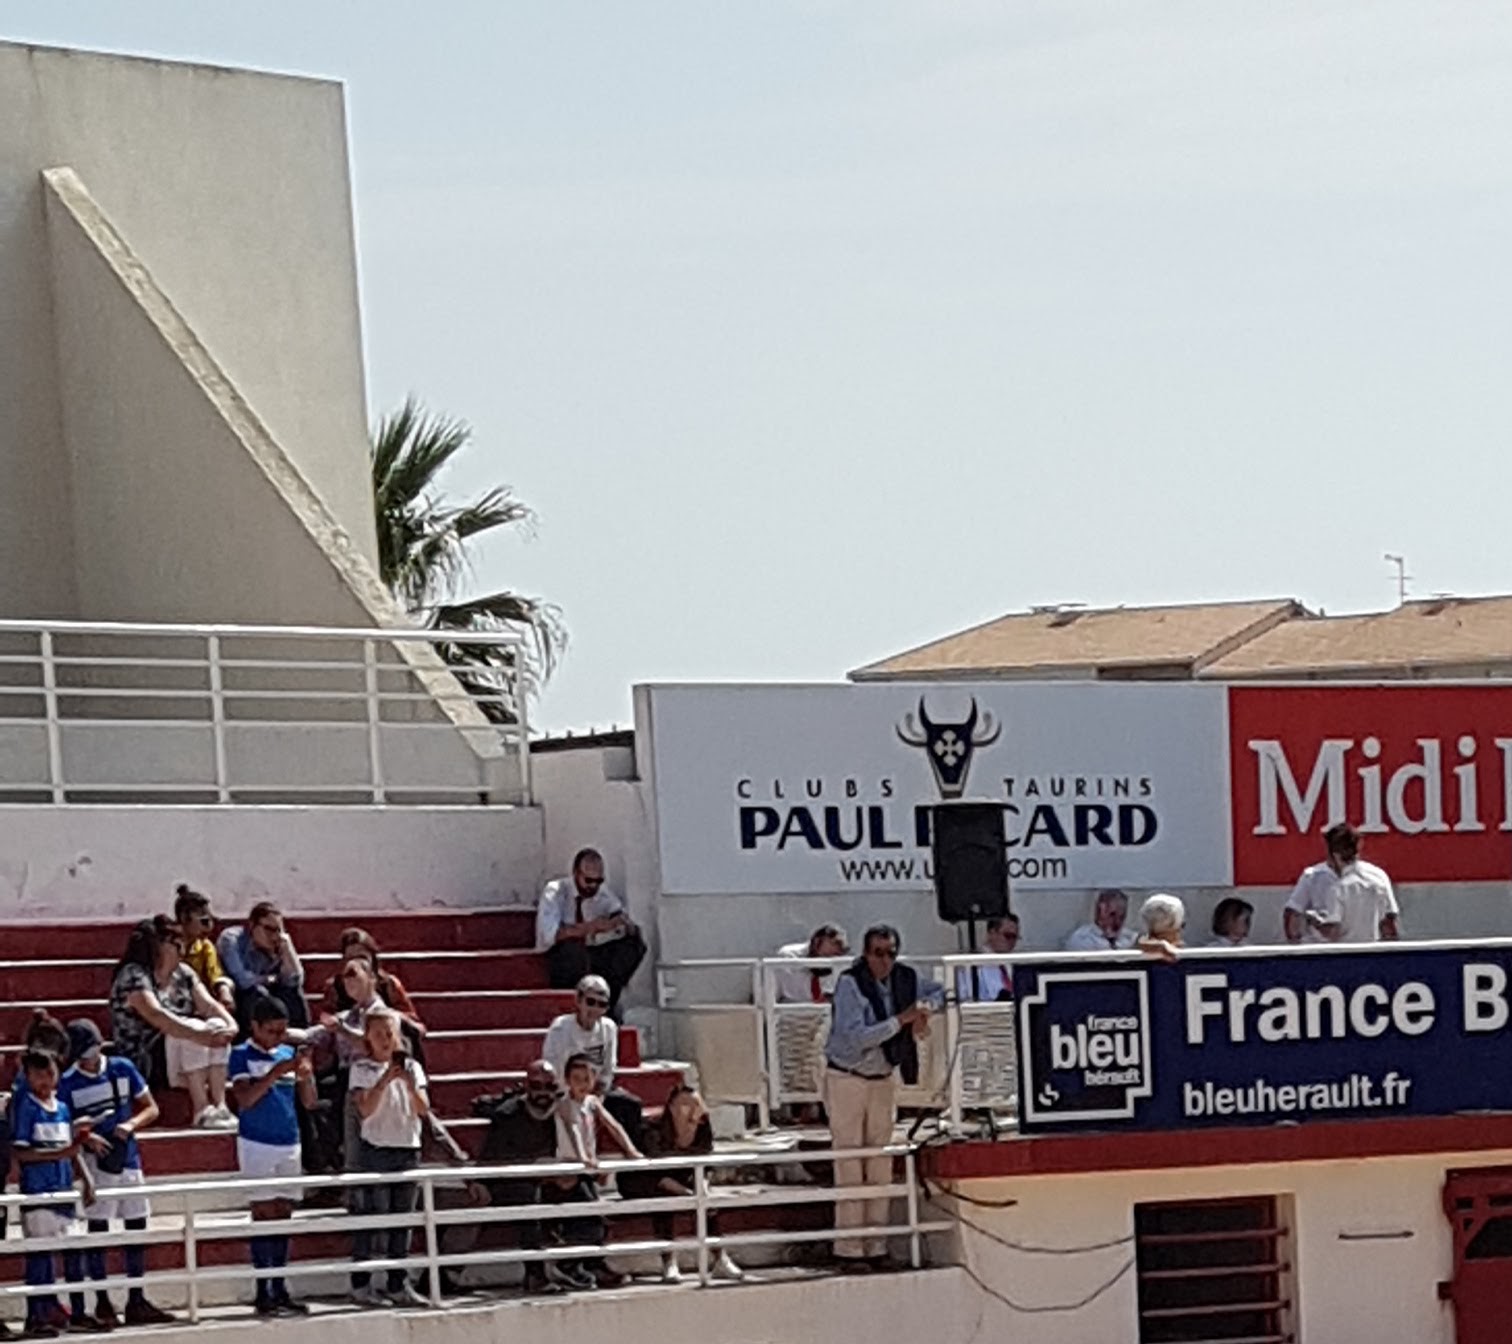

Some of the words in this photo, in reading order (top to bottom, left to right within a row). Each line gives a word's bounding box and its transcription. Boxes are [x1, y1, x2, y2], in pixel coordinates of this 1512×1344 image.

[737, 777, 894, 799] CLUBS
[1002, 776, 1154, 798] TAURINS
[1248, 735, 1486, 836] Midi
[738, 805, 903, 850] PAUL
[1185, 973, 1436, 1045] France
[1050, 1023, 1140, 1070] bleu
[1183, 1071, 1412, 1117] bleuherault.fr
